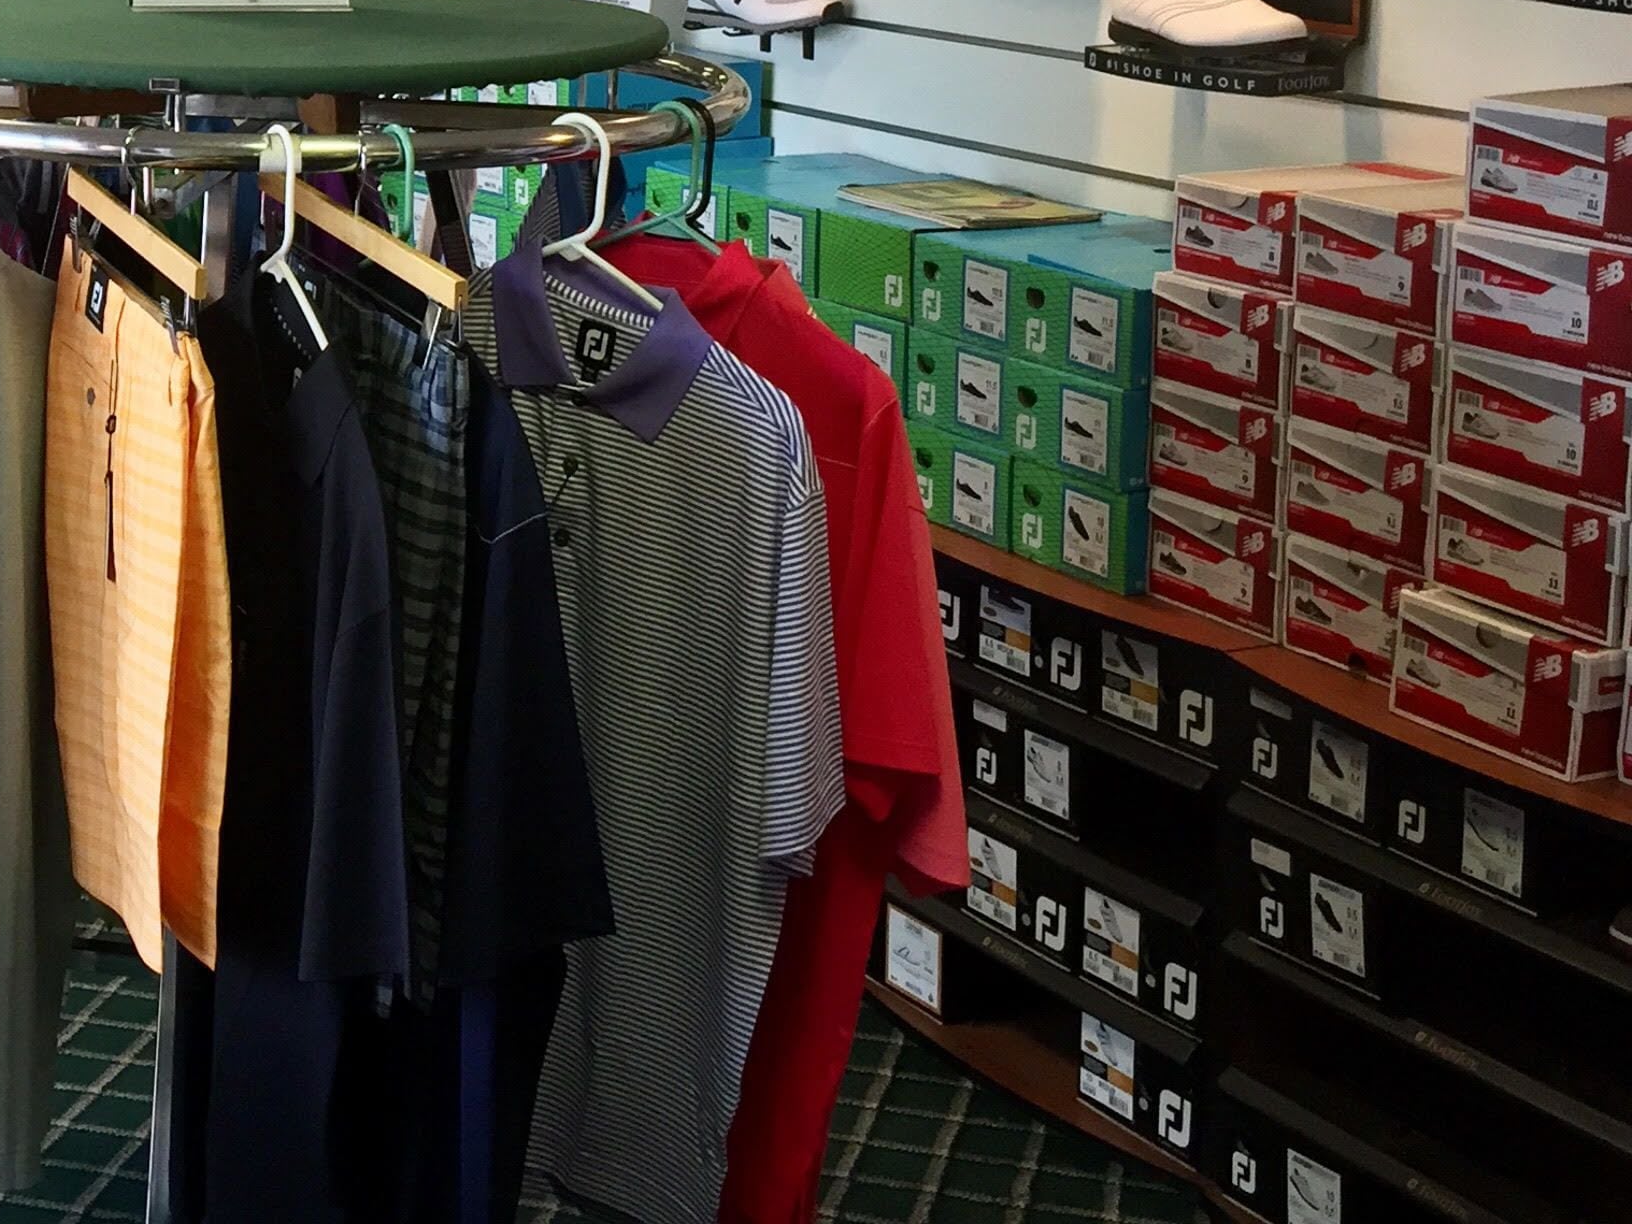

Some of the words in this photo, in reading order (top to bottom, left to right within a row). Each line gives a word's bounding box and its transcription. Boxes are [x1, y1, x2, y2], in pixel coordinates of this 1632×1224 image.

[1123, 62, 1163, 80] SHOE
[1174, 71, 1192, 84] IN
[1202, 75, 1256, 92] GOLF
[583, 328, 609, 360] FJ
[1025, 317, 1047, 353] FJ
[1571, 317, 1582, 329] 10
[1016, 413, 1037, 450] FJ
[1023, 513, 1043, 549] FJ
[1050, 636, 1082, 691] FJ
[1179, 689, 1214, 747] FJ
[976, 747, 997, 785] FJ
[1252, 736, 1278, 779] FJ
[1398, 798, 1426, 844] FJ
[1035, 895, 1067, 952] FJ
[1260, 896, 1284, 939] FJ
[1163, 962, 1198, 1022] FJ
[1158, 1088, 1192, 1149] FJ
[1232, 1151, 1256, 1194] FJ
